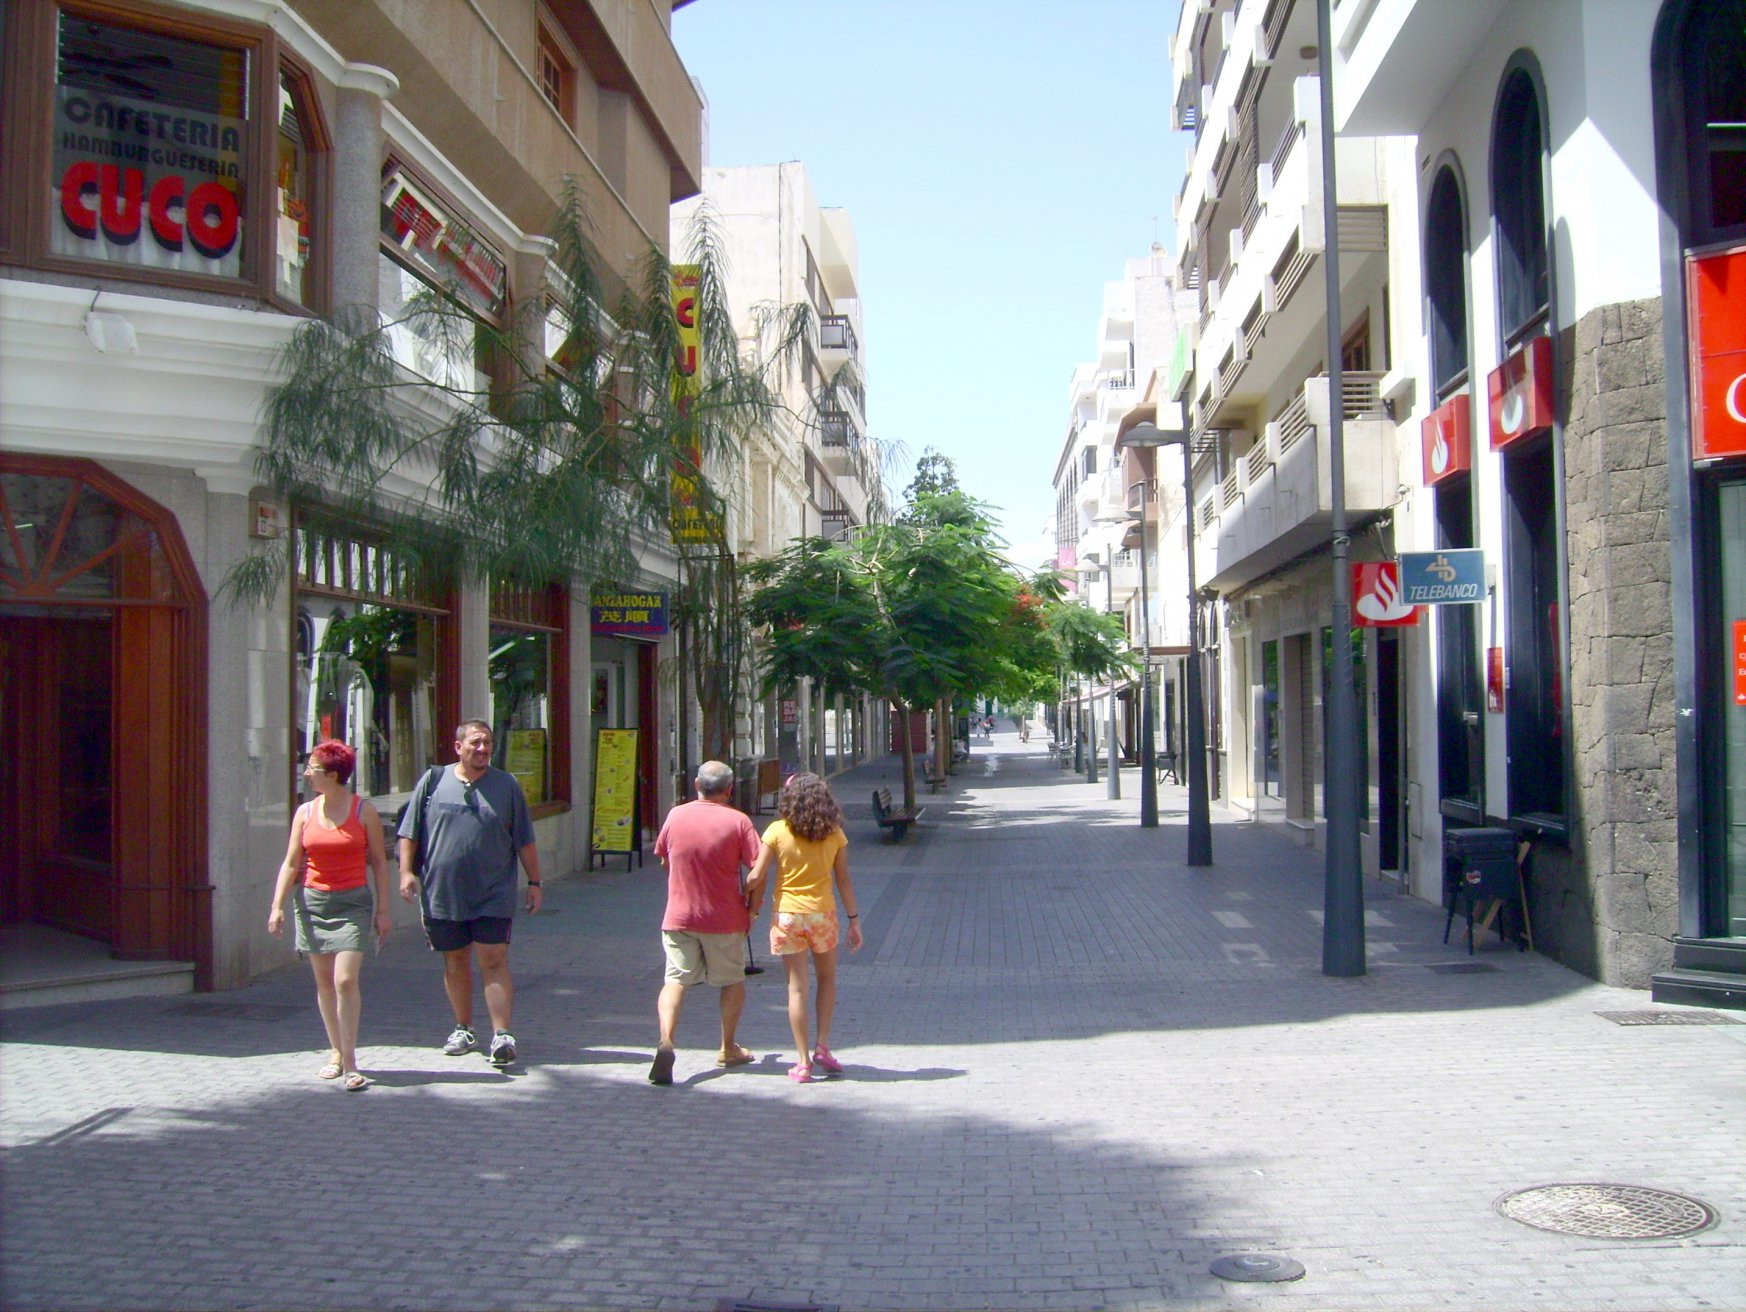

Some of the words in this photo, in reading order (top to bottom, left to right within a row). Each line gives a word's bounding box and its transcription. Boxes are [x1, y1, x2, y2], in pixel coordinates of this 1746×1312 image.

[64, 96, 240, 153] CAFETERIA
[62, 131, 240, 179] HAMBURGUESERIA
[61, 160, 240, 259] CUCO
[1410, 583, 1478, 600] TELEBANCO
